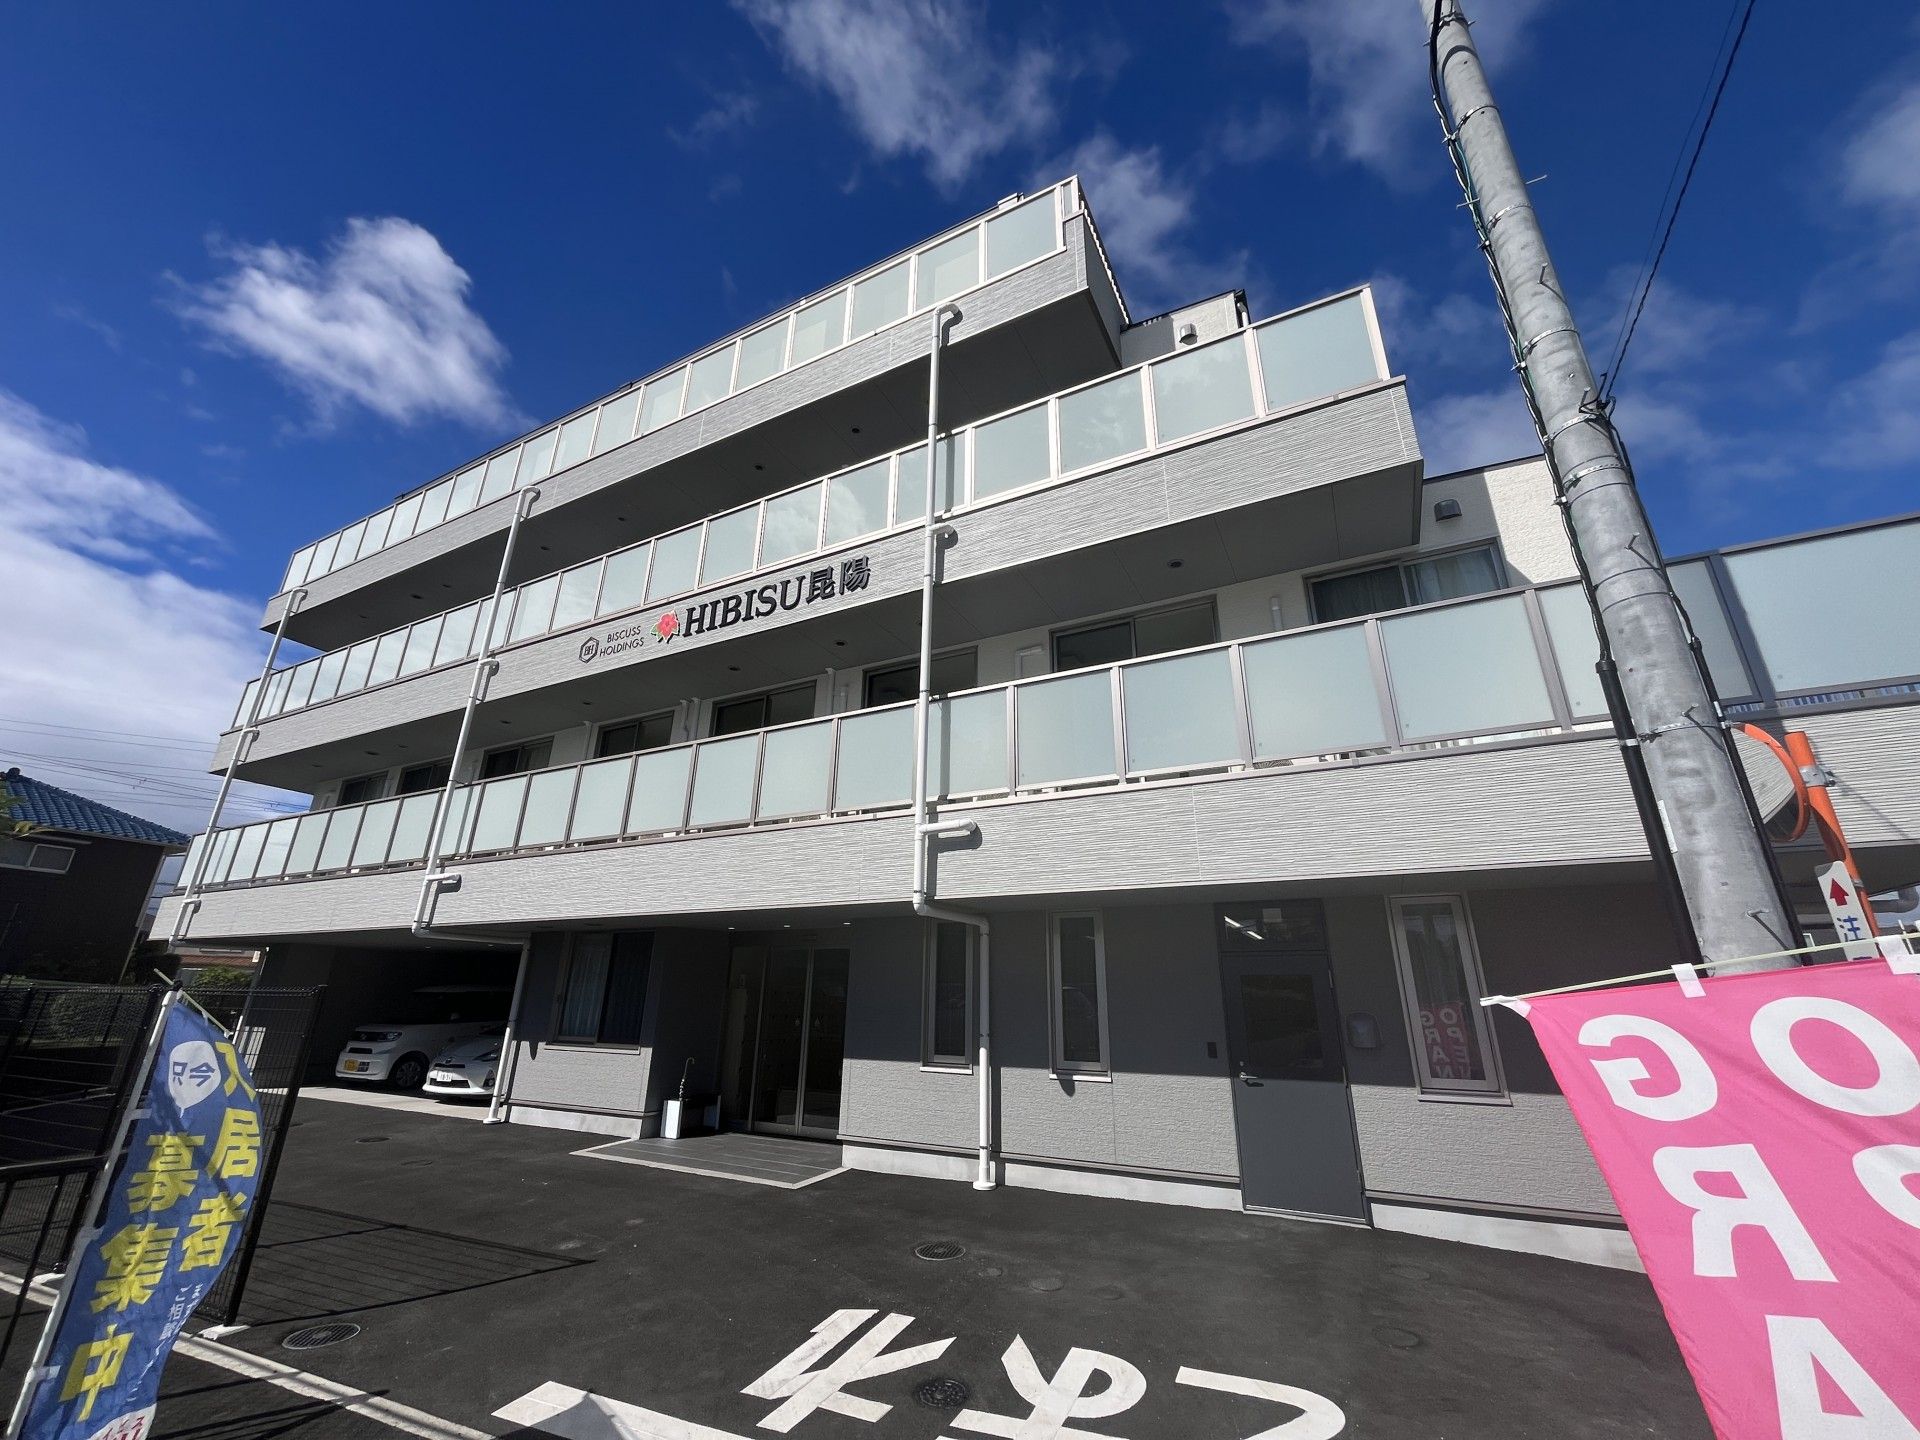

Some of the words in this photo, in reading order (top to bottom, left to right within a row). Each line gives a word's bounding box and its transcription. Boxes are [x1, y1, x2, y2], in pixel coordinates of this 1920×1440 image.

[683, 555, 871, 638] HIBISU昆陽
[599, 636, 645, 657] HOLDINGS
[606, 625, 642, 643] BISCUSS
[172, 1061, 216, 1088] 只今
[180, 1041, 261, 1273] 入居者
[59, 1131, 206, 1423] 募集中
